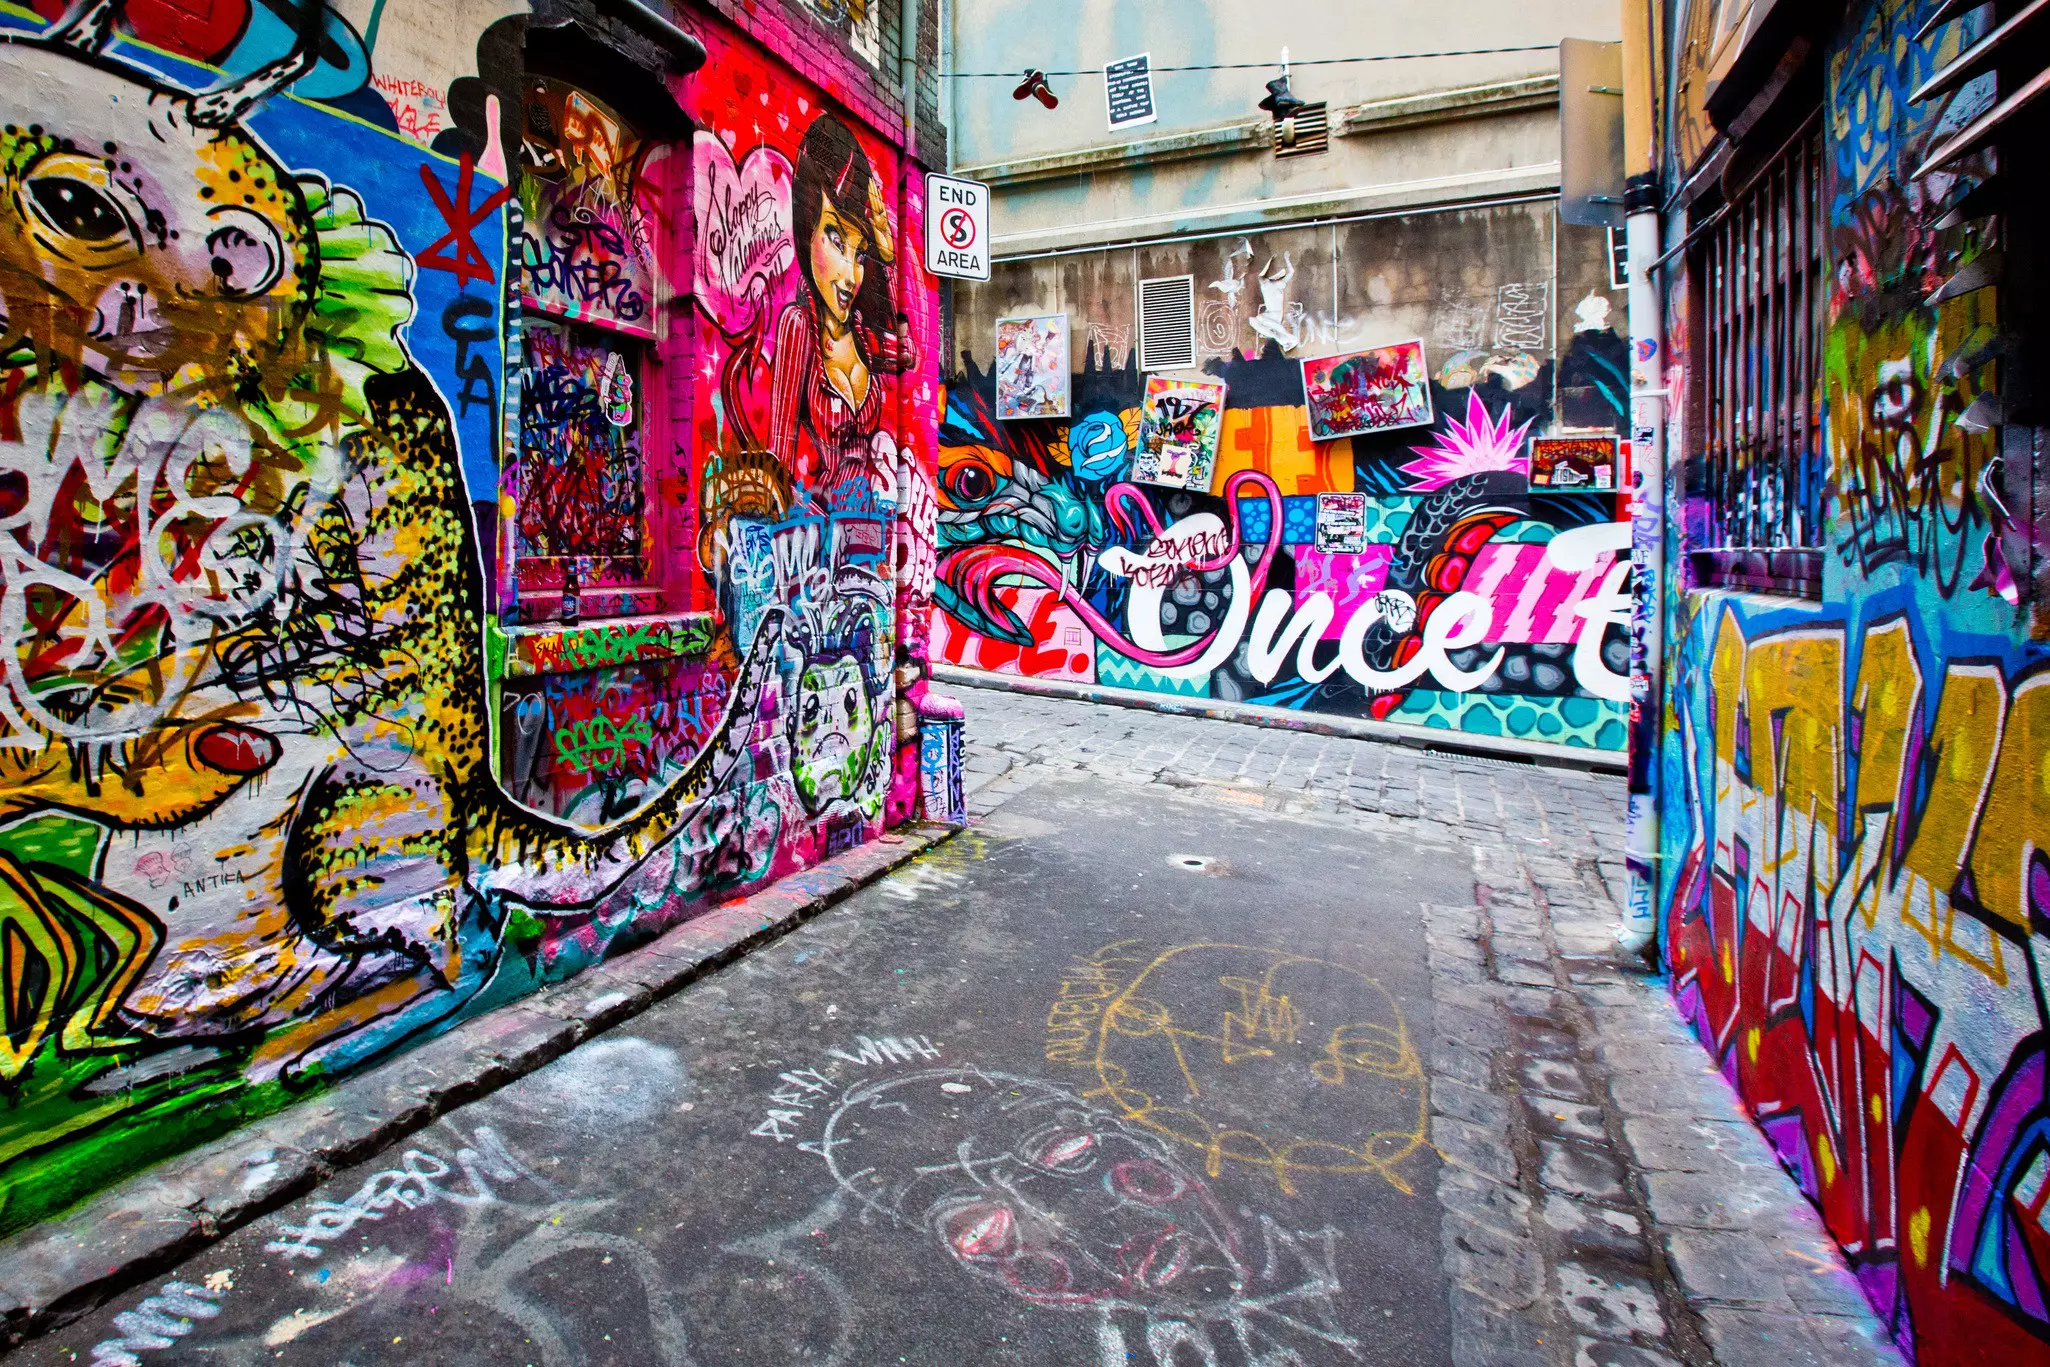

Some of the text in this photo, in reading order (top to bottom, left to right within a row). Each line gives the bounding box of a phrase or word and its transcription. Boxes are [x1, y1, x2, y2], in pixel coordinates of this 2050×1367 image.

[939, 185, 977, 206] END
[937, 250, 981, 271] AREA
[1097, 512, 1506, 692] Once
[182, 869, 245, 898] ANTIFA
